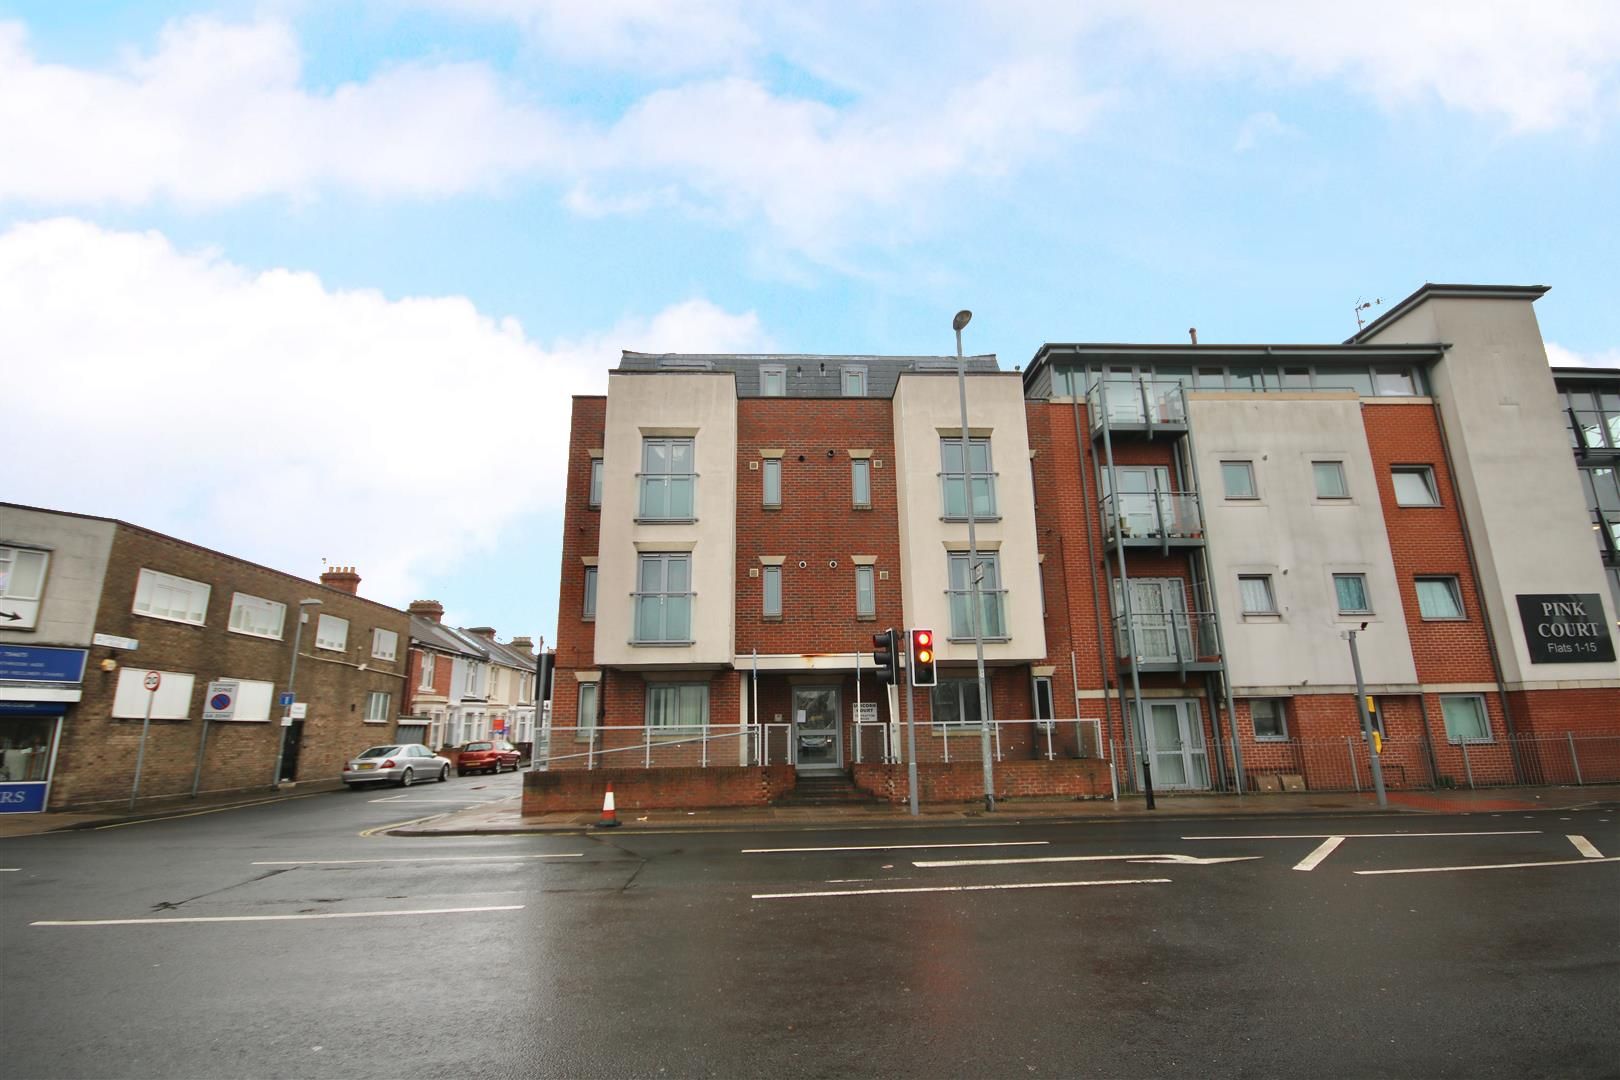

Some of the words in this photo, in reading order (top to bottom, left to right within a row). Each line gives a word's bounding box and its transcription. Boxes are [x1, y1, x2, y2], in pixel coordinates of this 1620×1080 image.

[1541, 602, 1587, 617] PINK
[1538, 622, 1599, 638] COURT
[1547, 643, 1573, 653] Flats
[1574, 642, 1597, 653] 1-15
[0, 790, 26, 804] RS
